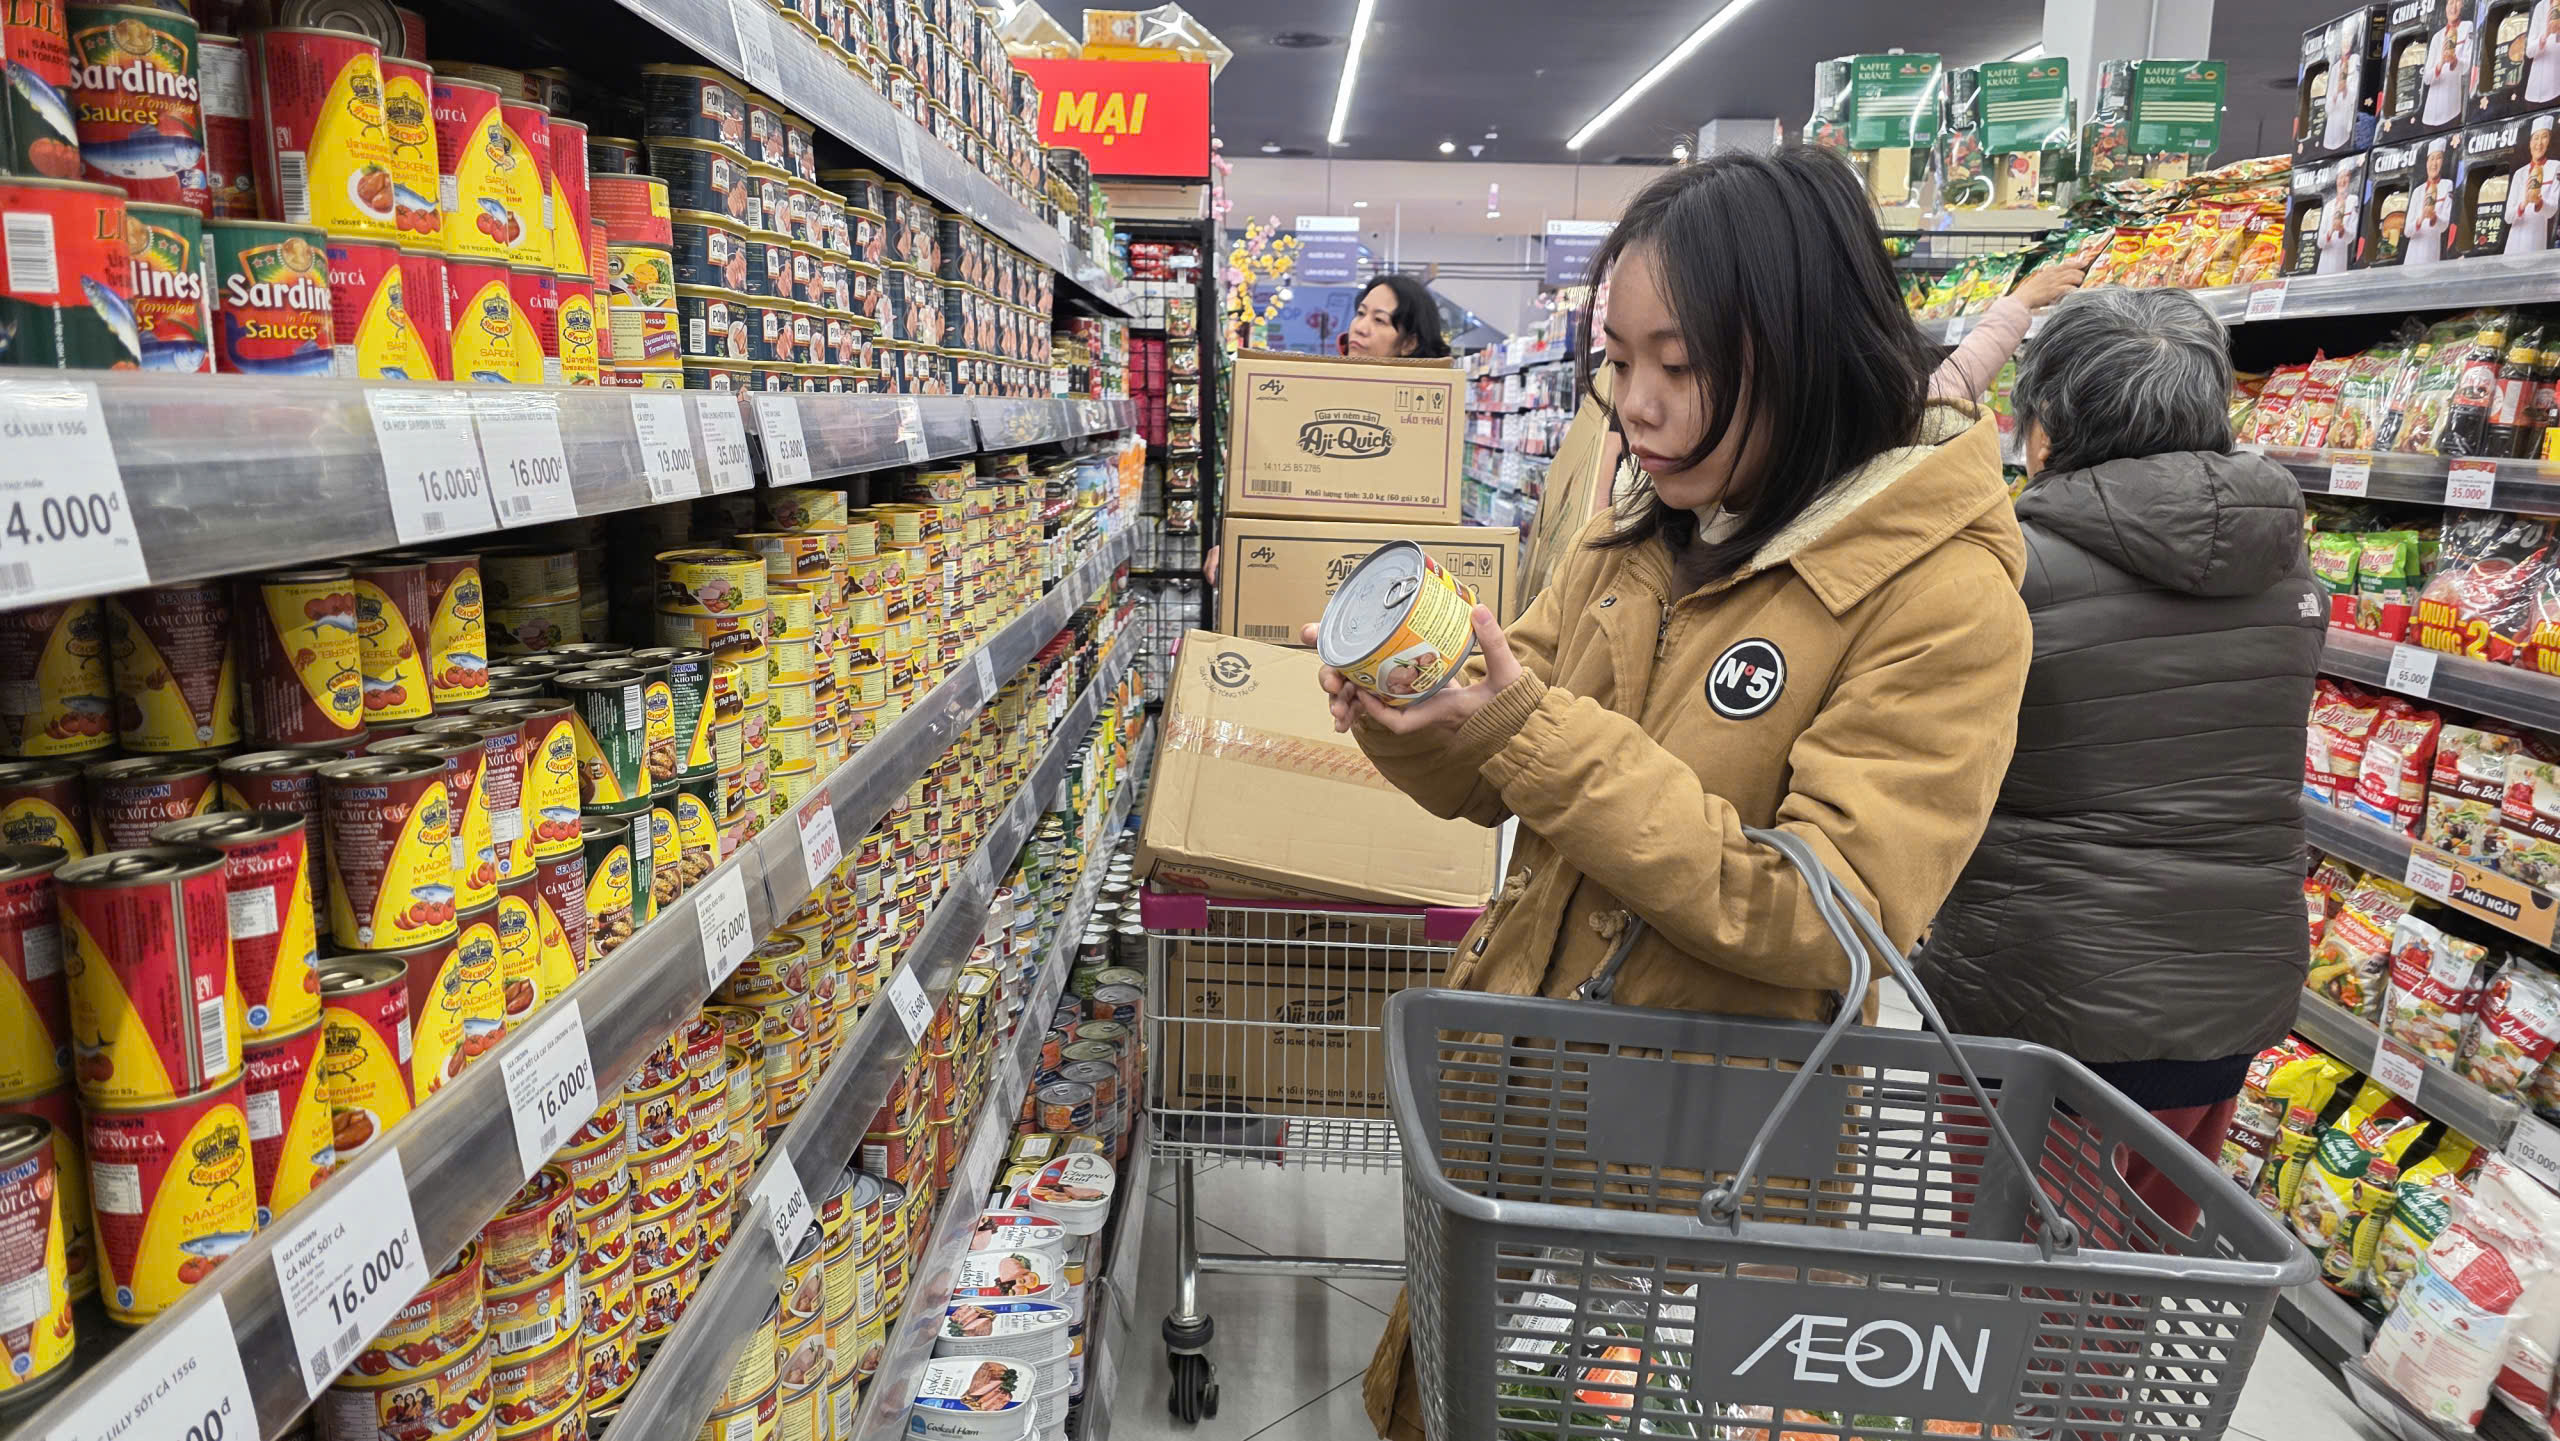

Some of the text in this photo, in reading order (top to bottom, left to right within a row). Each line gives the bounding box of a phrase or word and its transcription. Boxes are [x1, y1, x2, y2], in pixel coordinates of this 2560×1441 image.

[71, 57, 199, 101] Sardines
[1860, 63, 1890, 72] KAFFEE
[1987, 69, 2018, 77] KAFFEE
[2144, 67, 2177, 76] KAFFEE
[80, 104, 158, 125] Sauces
[1053, 92, 1147, 145] MẠI
[2468, 129, 2518, 154] CHIN-SU
[2375, 149, 2417, 173] CHIN-SU
[245, 320, 318, 340] Sauces
[1318, 412, 1331, 421] Gia
[1298, 426, 1393, 456] Aji-Quick
[0, 491, 120, 546] 4.000đ
[716, 620, 739, 628] VISSAN
[2420, 601, 2447, 628] MUA
[2467, 620, 2490, 662] 2
[486, 733, 517, 749] CROWN
[2432, 766, 2458, 782] eptune
[2502, 802, 2534, 819] eptune
[2485, 896, 2518, 918] NGÀY
[538, 1058, 588, 1124] 16.000đ
[905, 1116, 926, 1154] SPAM
[910, 1187, 931, 1227] SPAM
[328, 1227, 410, 1327] 16.000đ
